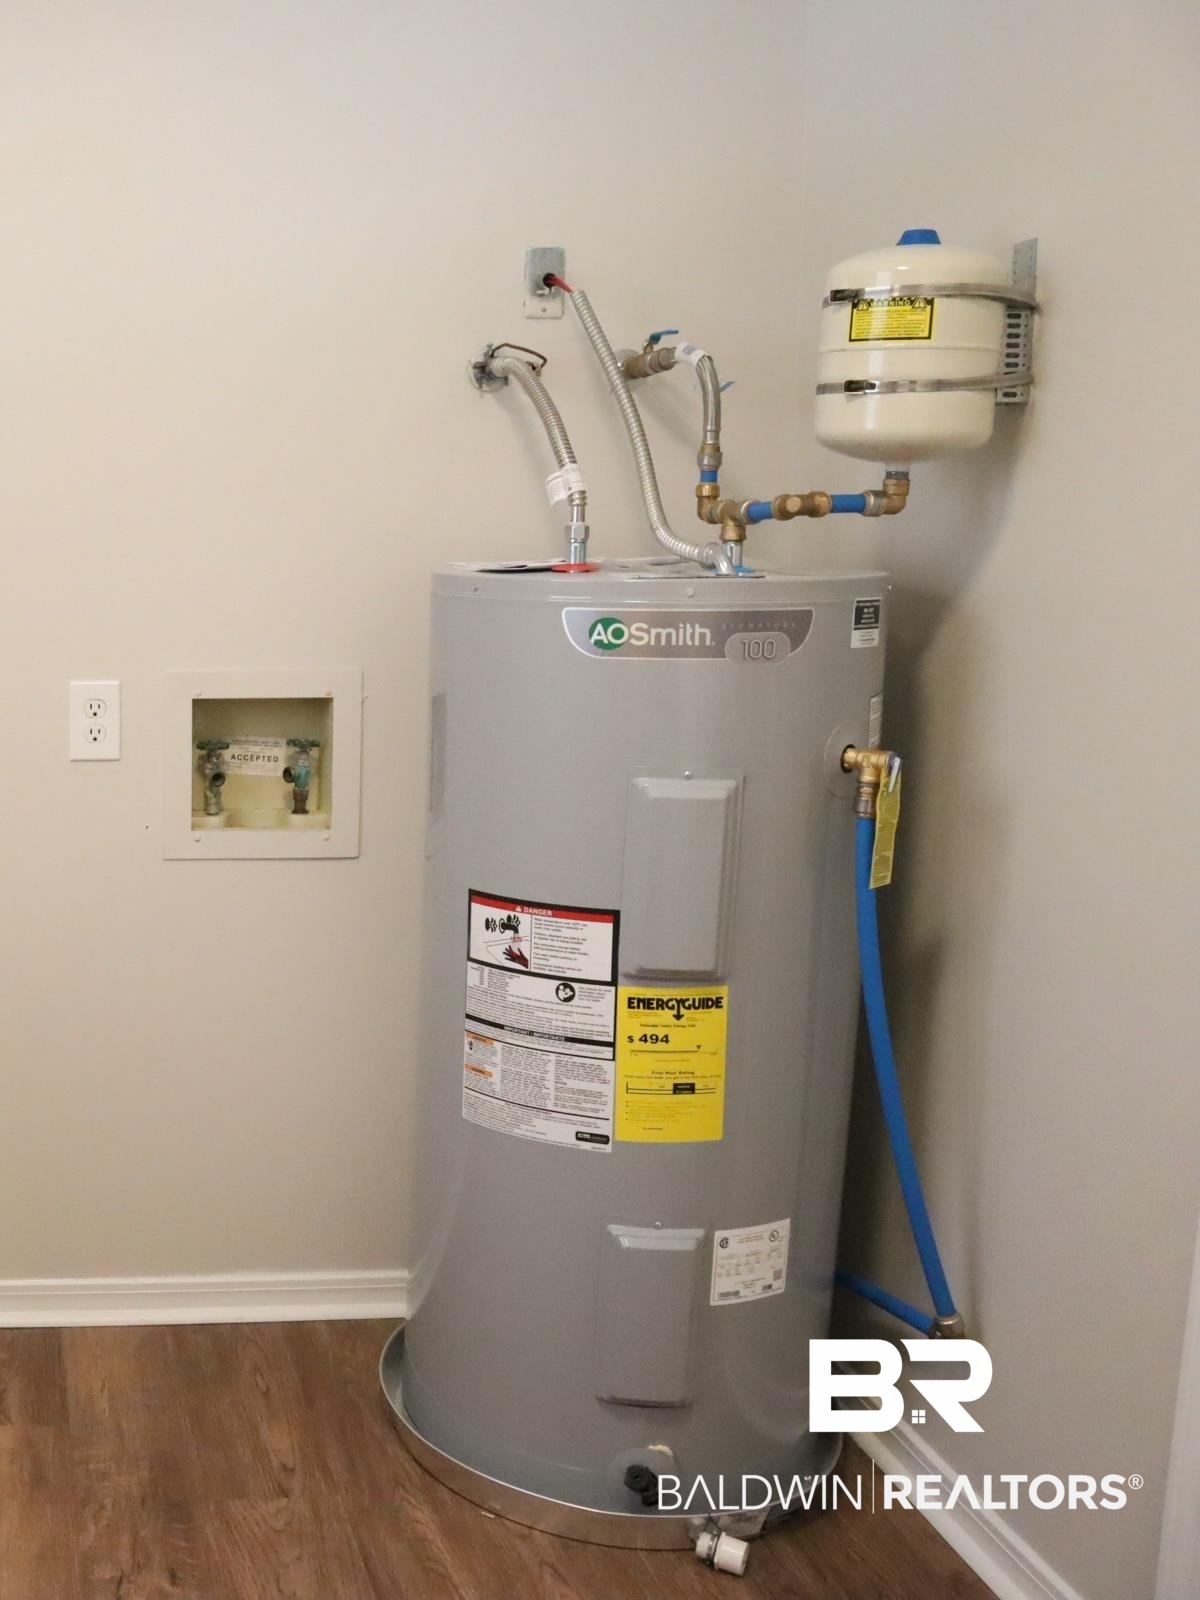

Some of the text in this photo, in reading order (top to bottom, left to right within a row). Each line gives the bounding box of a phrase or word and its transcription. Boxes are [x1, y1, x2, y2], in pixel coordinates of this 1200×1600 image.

[741, 639, 776, 659] 100
[230, 753, 279, 763] ACCEPTED
[523, 906, 553, 917] DANGER
[627, 996, 724, 1011] ENERGYGUIDE
[638, 1033, 670, 1045] 494
